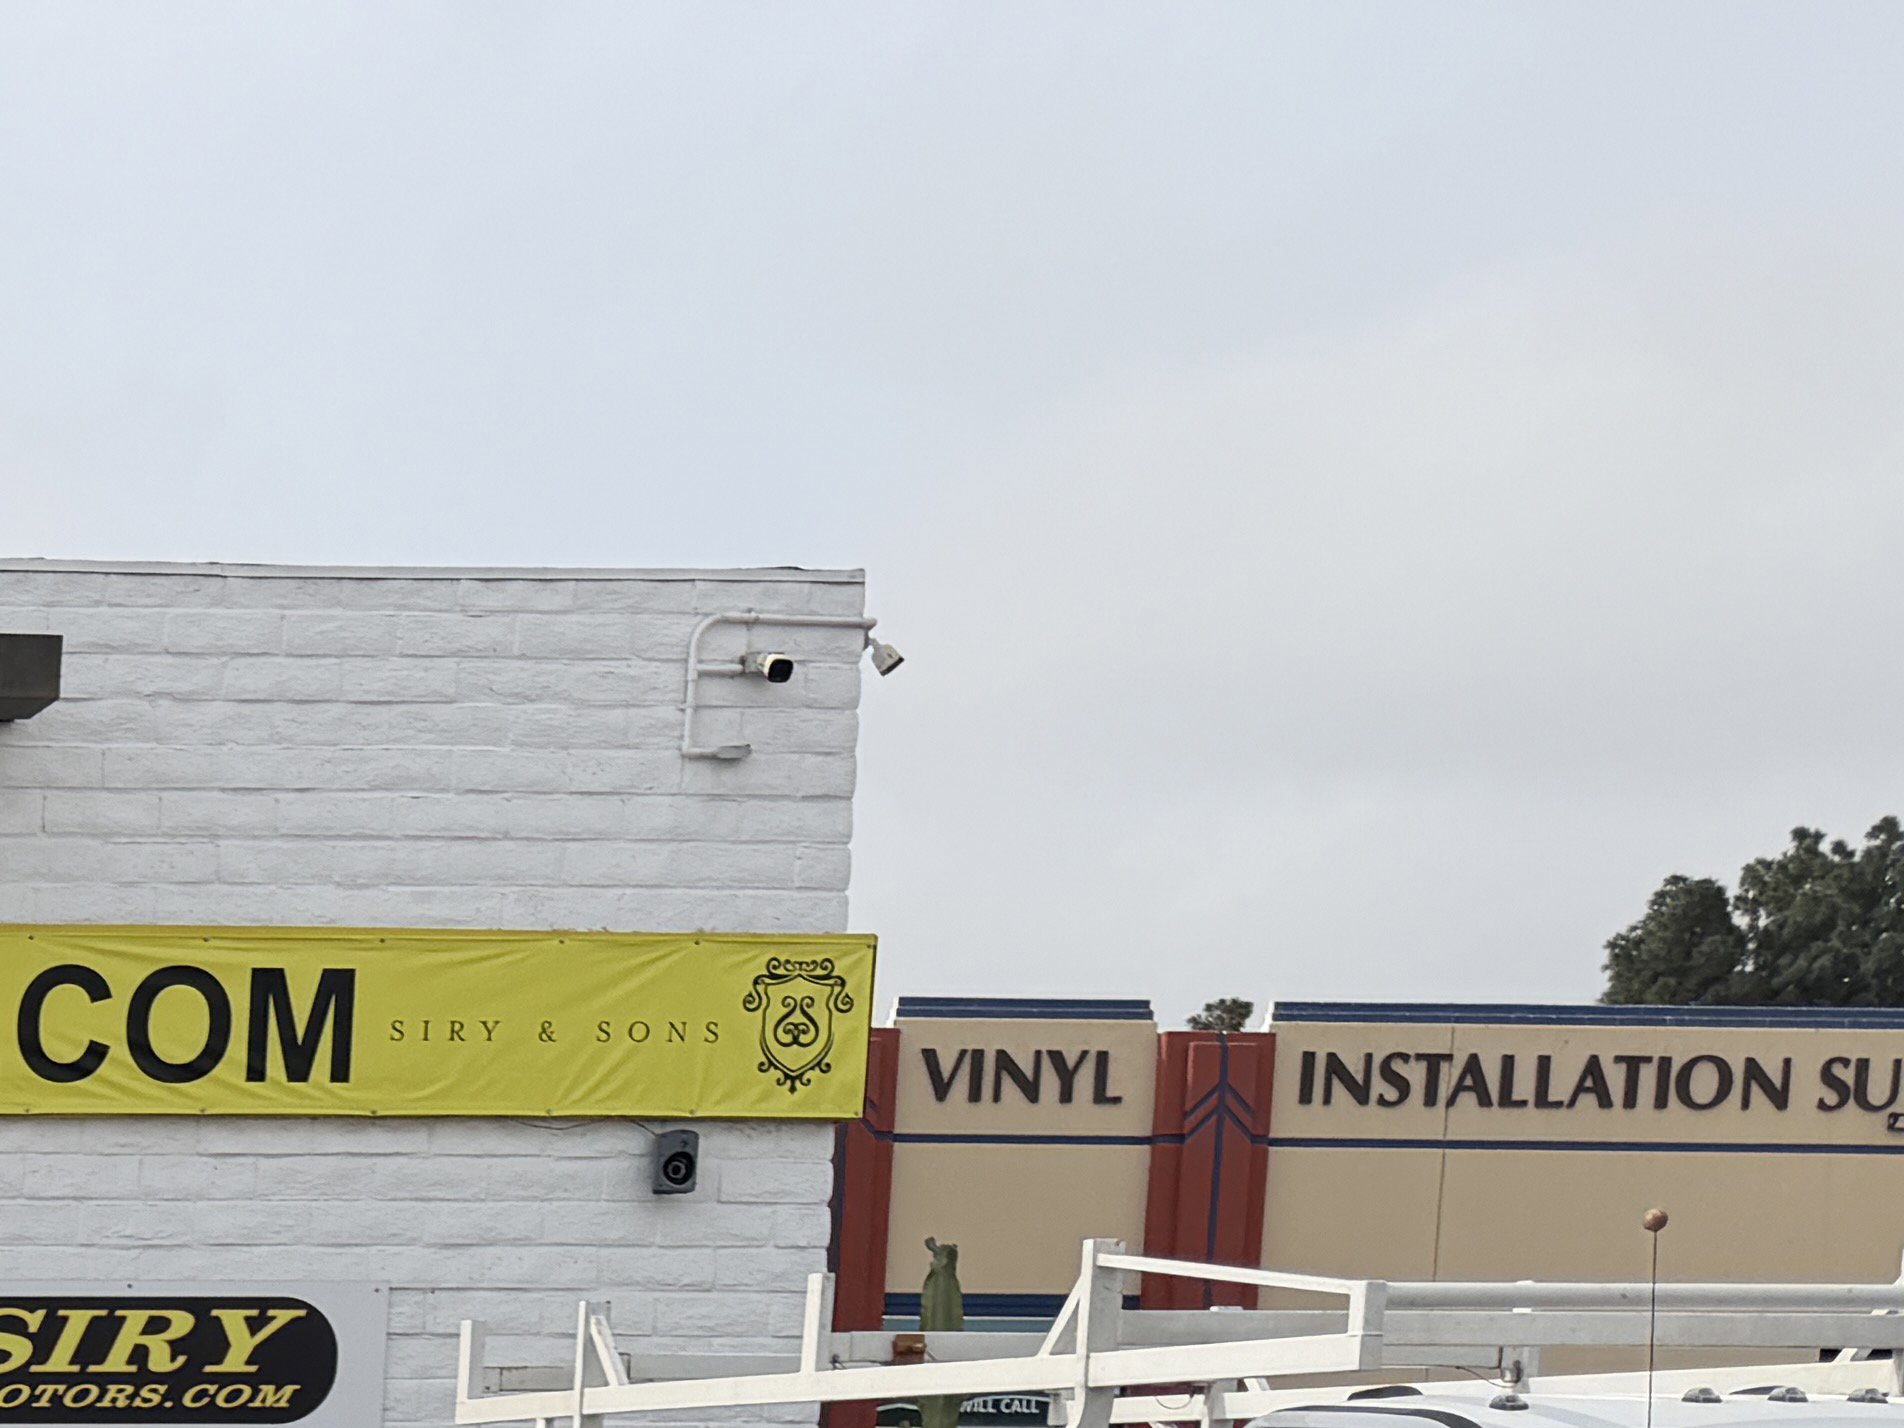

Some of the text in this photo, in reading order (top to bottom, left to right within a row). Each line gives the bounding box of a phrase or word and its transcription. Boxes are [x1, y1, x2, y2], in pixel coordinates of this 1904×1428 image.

[388, 1019, 721, 1044] SIRY & SONS
[921, 1047, 1123, 1105] VINYL
[1298, 1049, 1793, 1112] INSTALLATION
[1000, 1400, 1040, 1414] CALL
